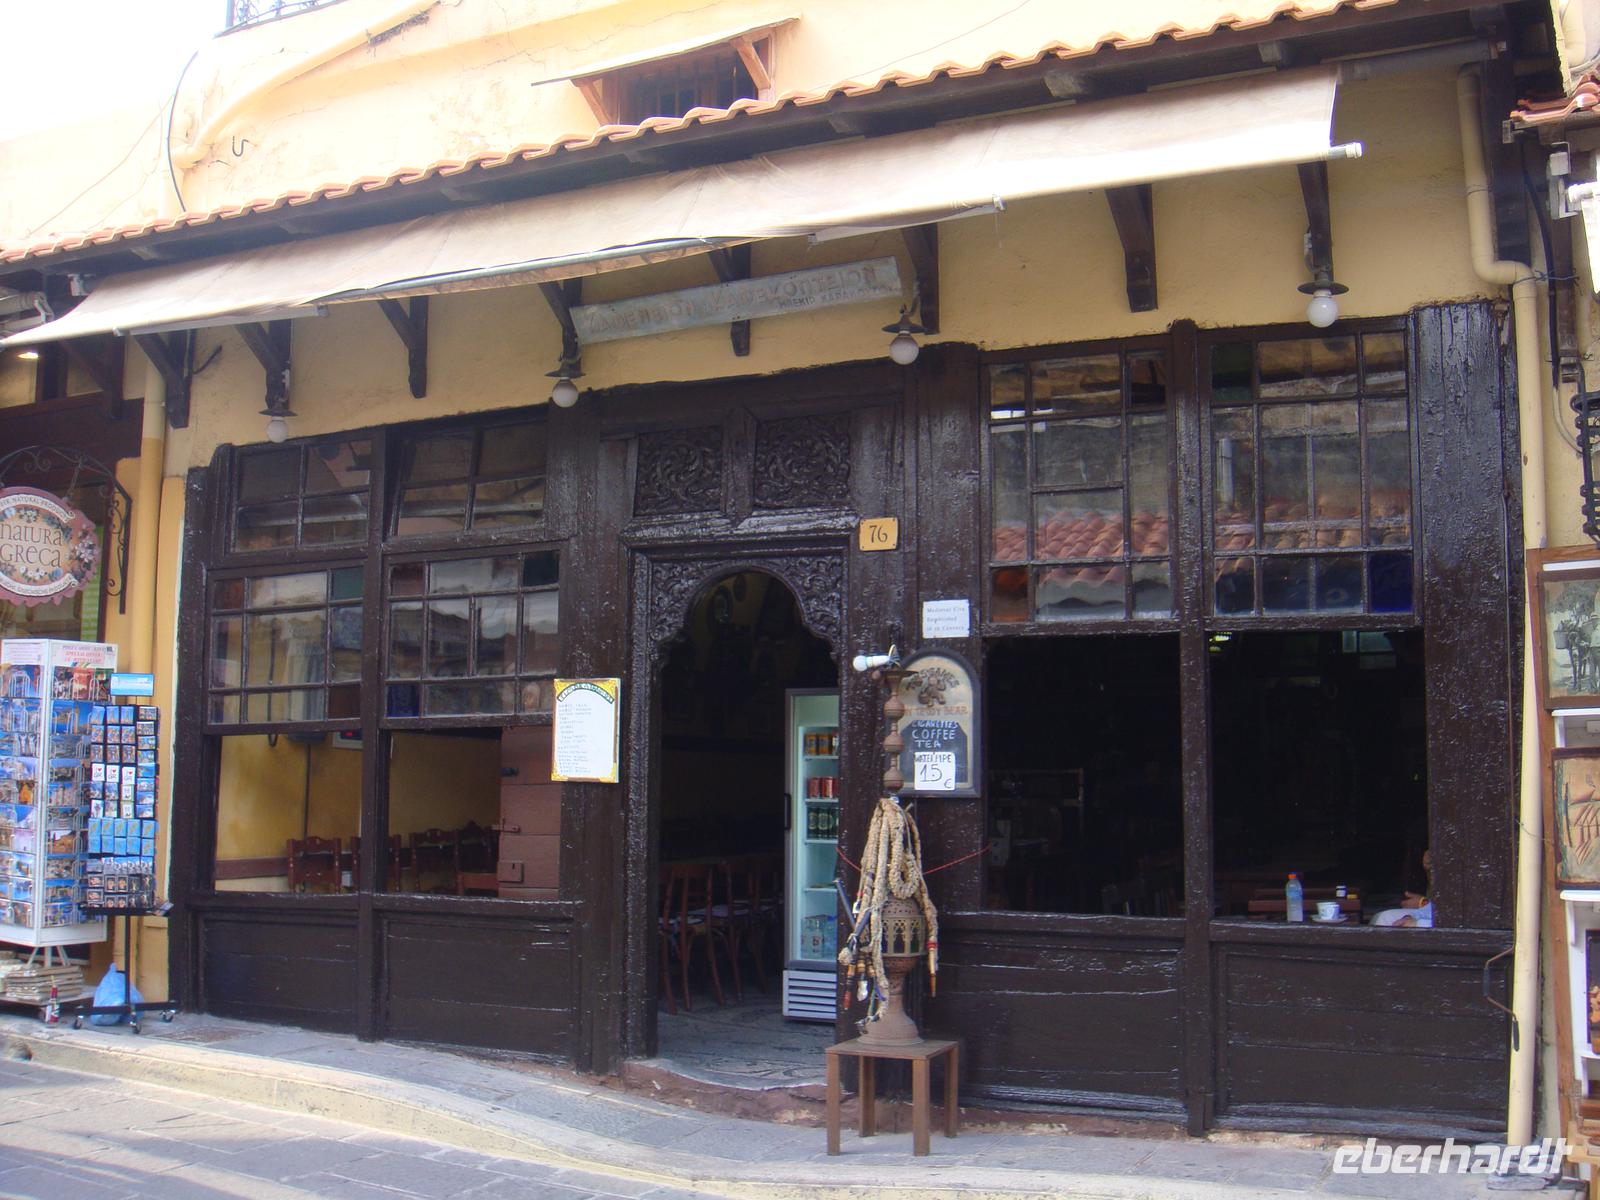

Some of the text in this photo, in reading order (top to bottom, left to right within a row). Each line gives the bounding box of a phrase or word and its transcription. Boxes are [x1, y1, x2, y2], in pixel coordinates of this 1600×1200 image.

[869, 525, 888, 544] 76
[911, 729, 956, 740] COFFEE
[914, 740, 942, 748] TEA
